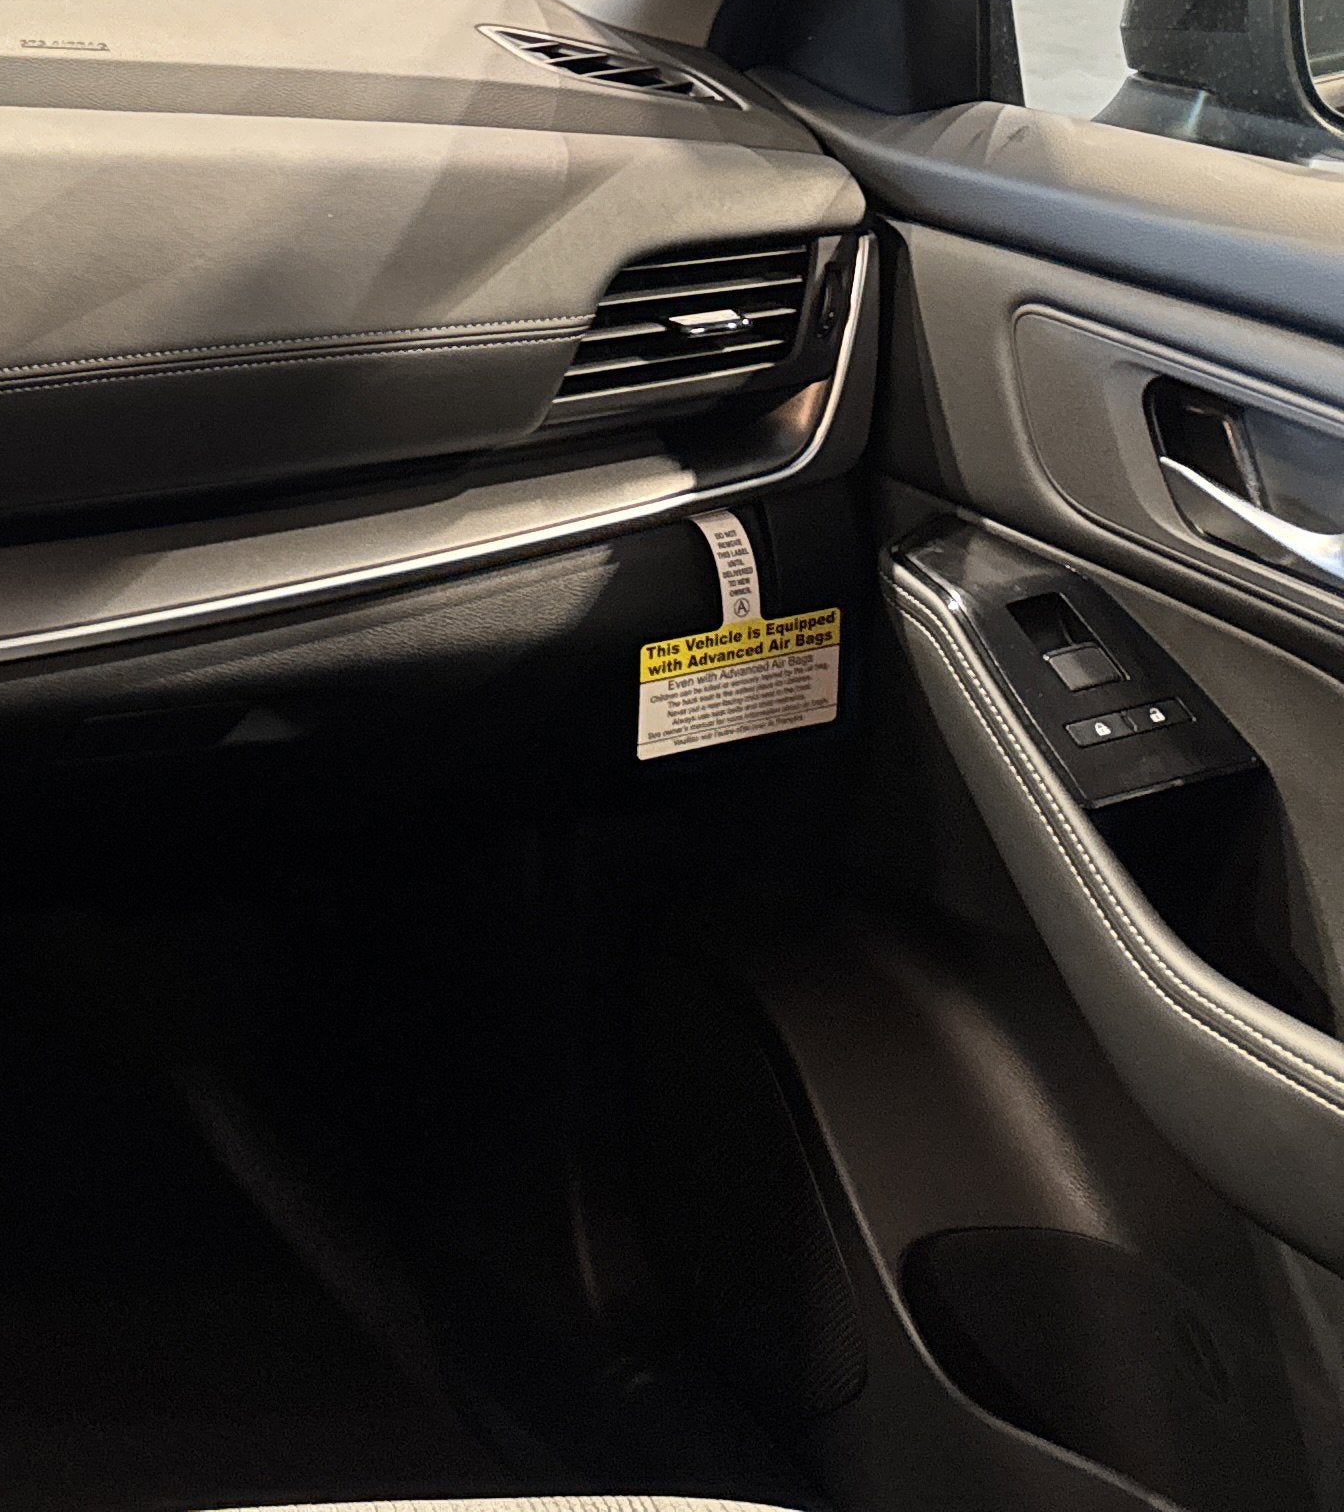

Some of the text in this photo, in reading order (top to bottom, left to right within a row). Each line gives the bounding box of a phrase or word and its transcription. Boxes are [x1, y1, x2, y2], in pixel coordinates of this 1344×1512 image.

[717, 547, 749, 559] THIS LABEL
[646, 610, 837, 660] This Vehicle is Equipped
[647, 629, 833, 676] with Advanced Air Bags
[667, 677, 694, 691] Even
[697, 672, 718, 685] with
[719, 659, 770, 680] Advanced
[772, 659, 786, 669] Air
[788, 654, 814, 667] Bags
